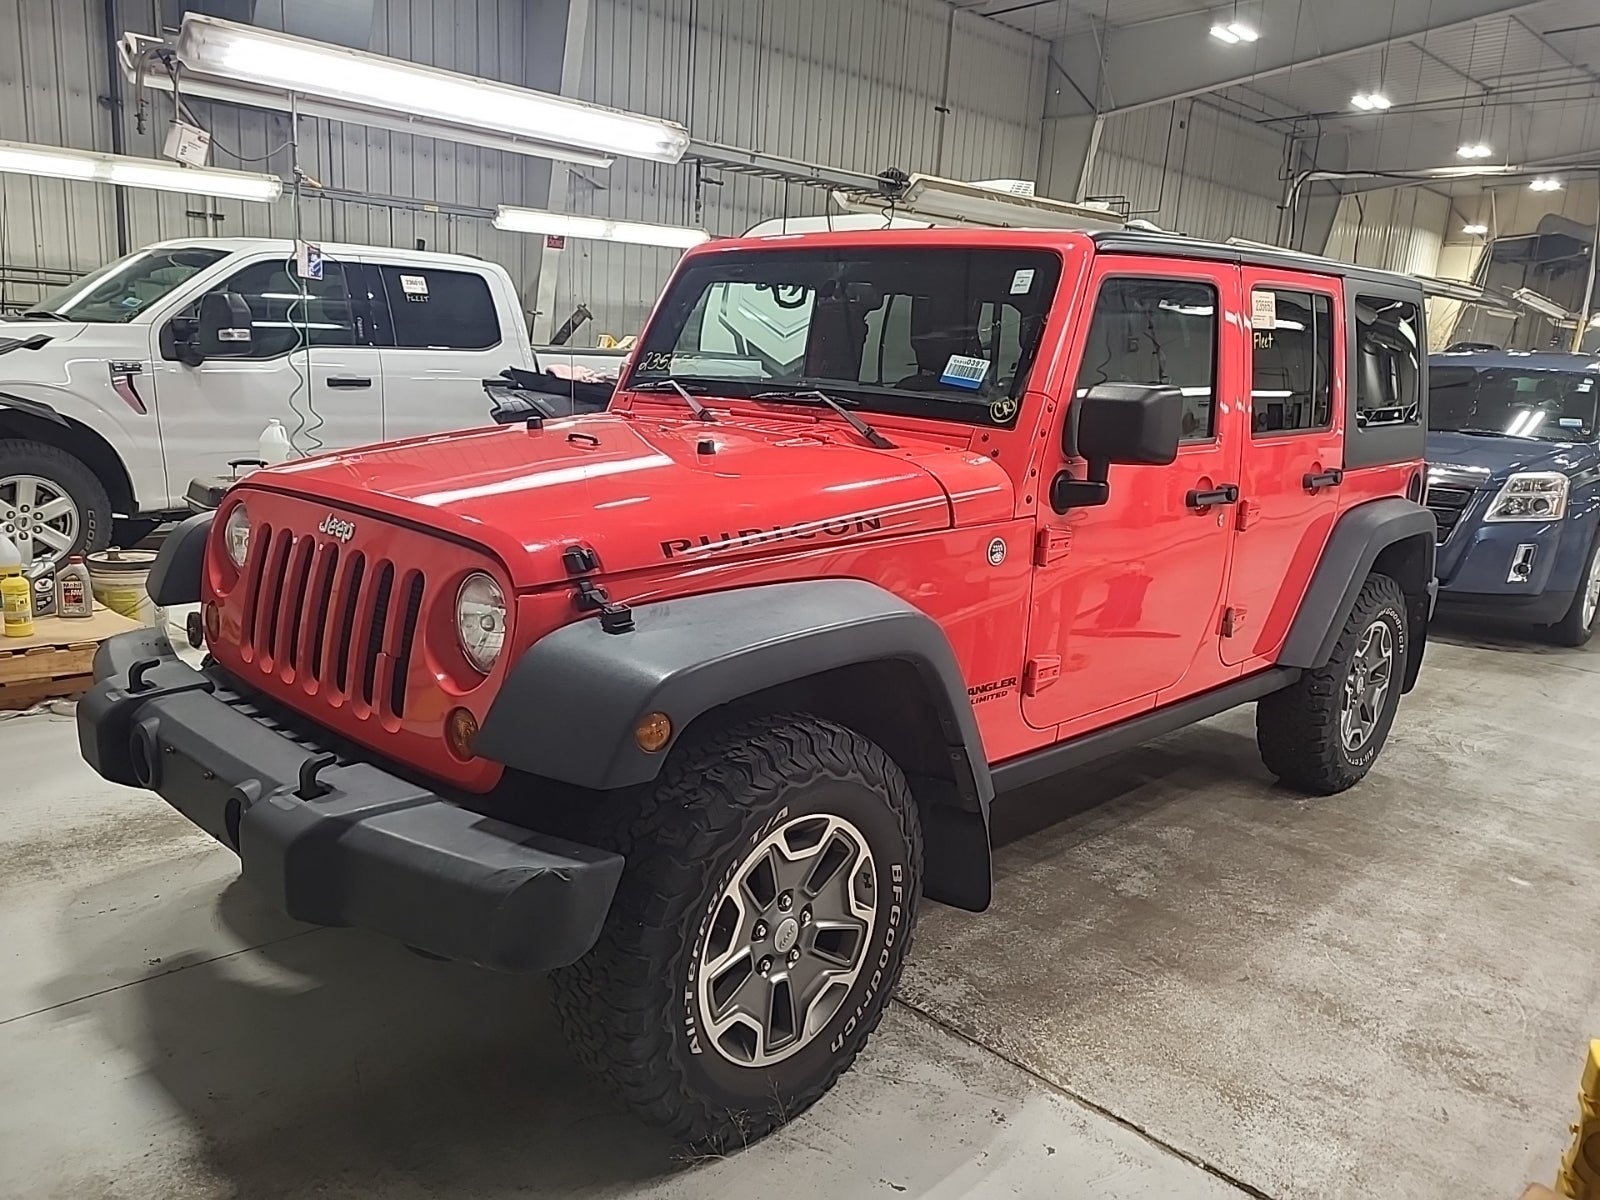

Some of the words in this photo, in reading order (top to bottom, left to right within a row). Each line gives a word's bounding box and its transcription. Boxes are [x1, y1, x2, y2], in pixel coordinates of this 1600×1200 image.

[1253, 332, 1274, 350] Fleet
[318, 512, 356, 544] Jeep
[659, 514, 882, 559] RUBICON
[967, 676, 1017, 696] ANGLER
[683, 858, 739, 1055] All-Terrain
[749, 805, 790, 845] T/A
[830, 863, 904, 1053] BFGoodrich
